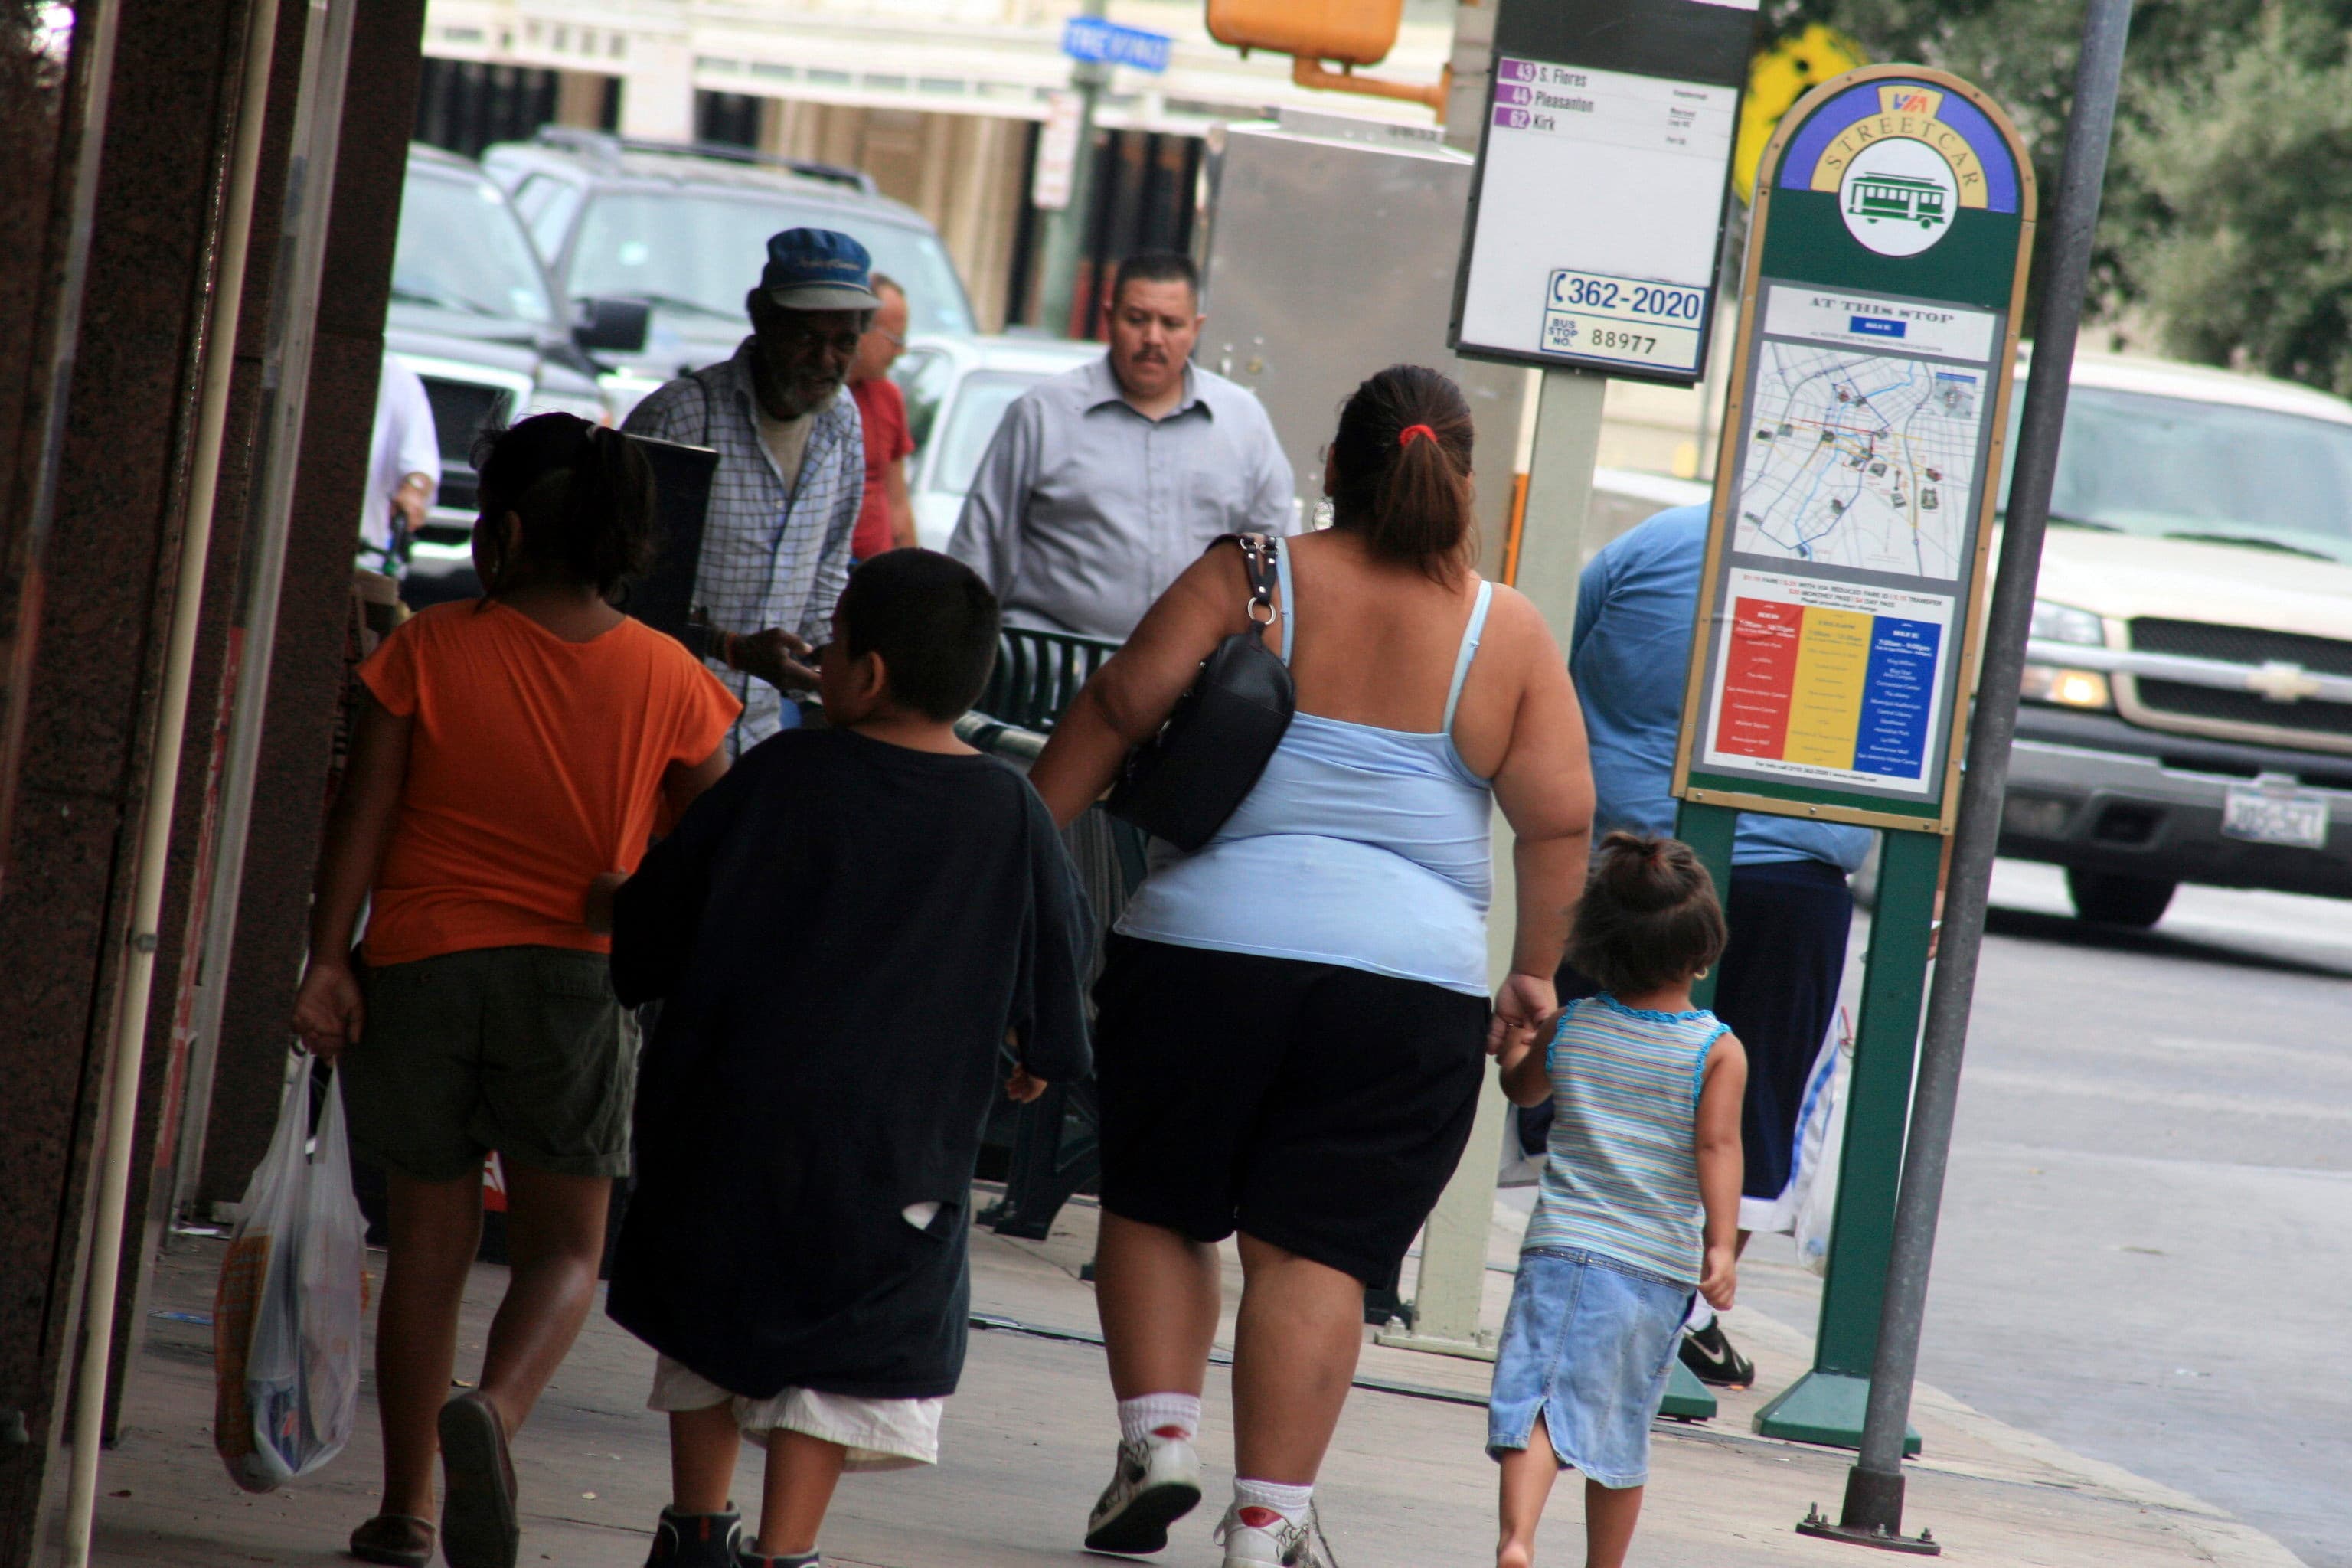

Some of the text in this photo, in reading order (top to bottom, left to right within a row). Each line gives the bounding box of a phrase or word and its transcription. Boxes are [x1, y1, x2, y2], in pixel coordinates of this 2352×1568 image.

[1515, 61, 1588, 87] 43 S. Flores
[1512, 87, 1594, 113] 44 Pleasanton
[1509, 111, 1557, 132] 62 Kirk
[1825, 115, 1980, 188] STREETCAR
[1568, 276, 1700, 321] 362-2020
[1808, 296, 1955, 325] AT THIS STOP
[1548, 326, 1579, 338] STOP
[1553, 317, 1576, 329] BUS
[1552, 336, 1574, 348] NO.
[1591, 328, 1658, 355] 88977
